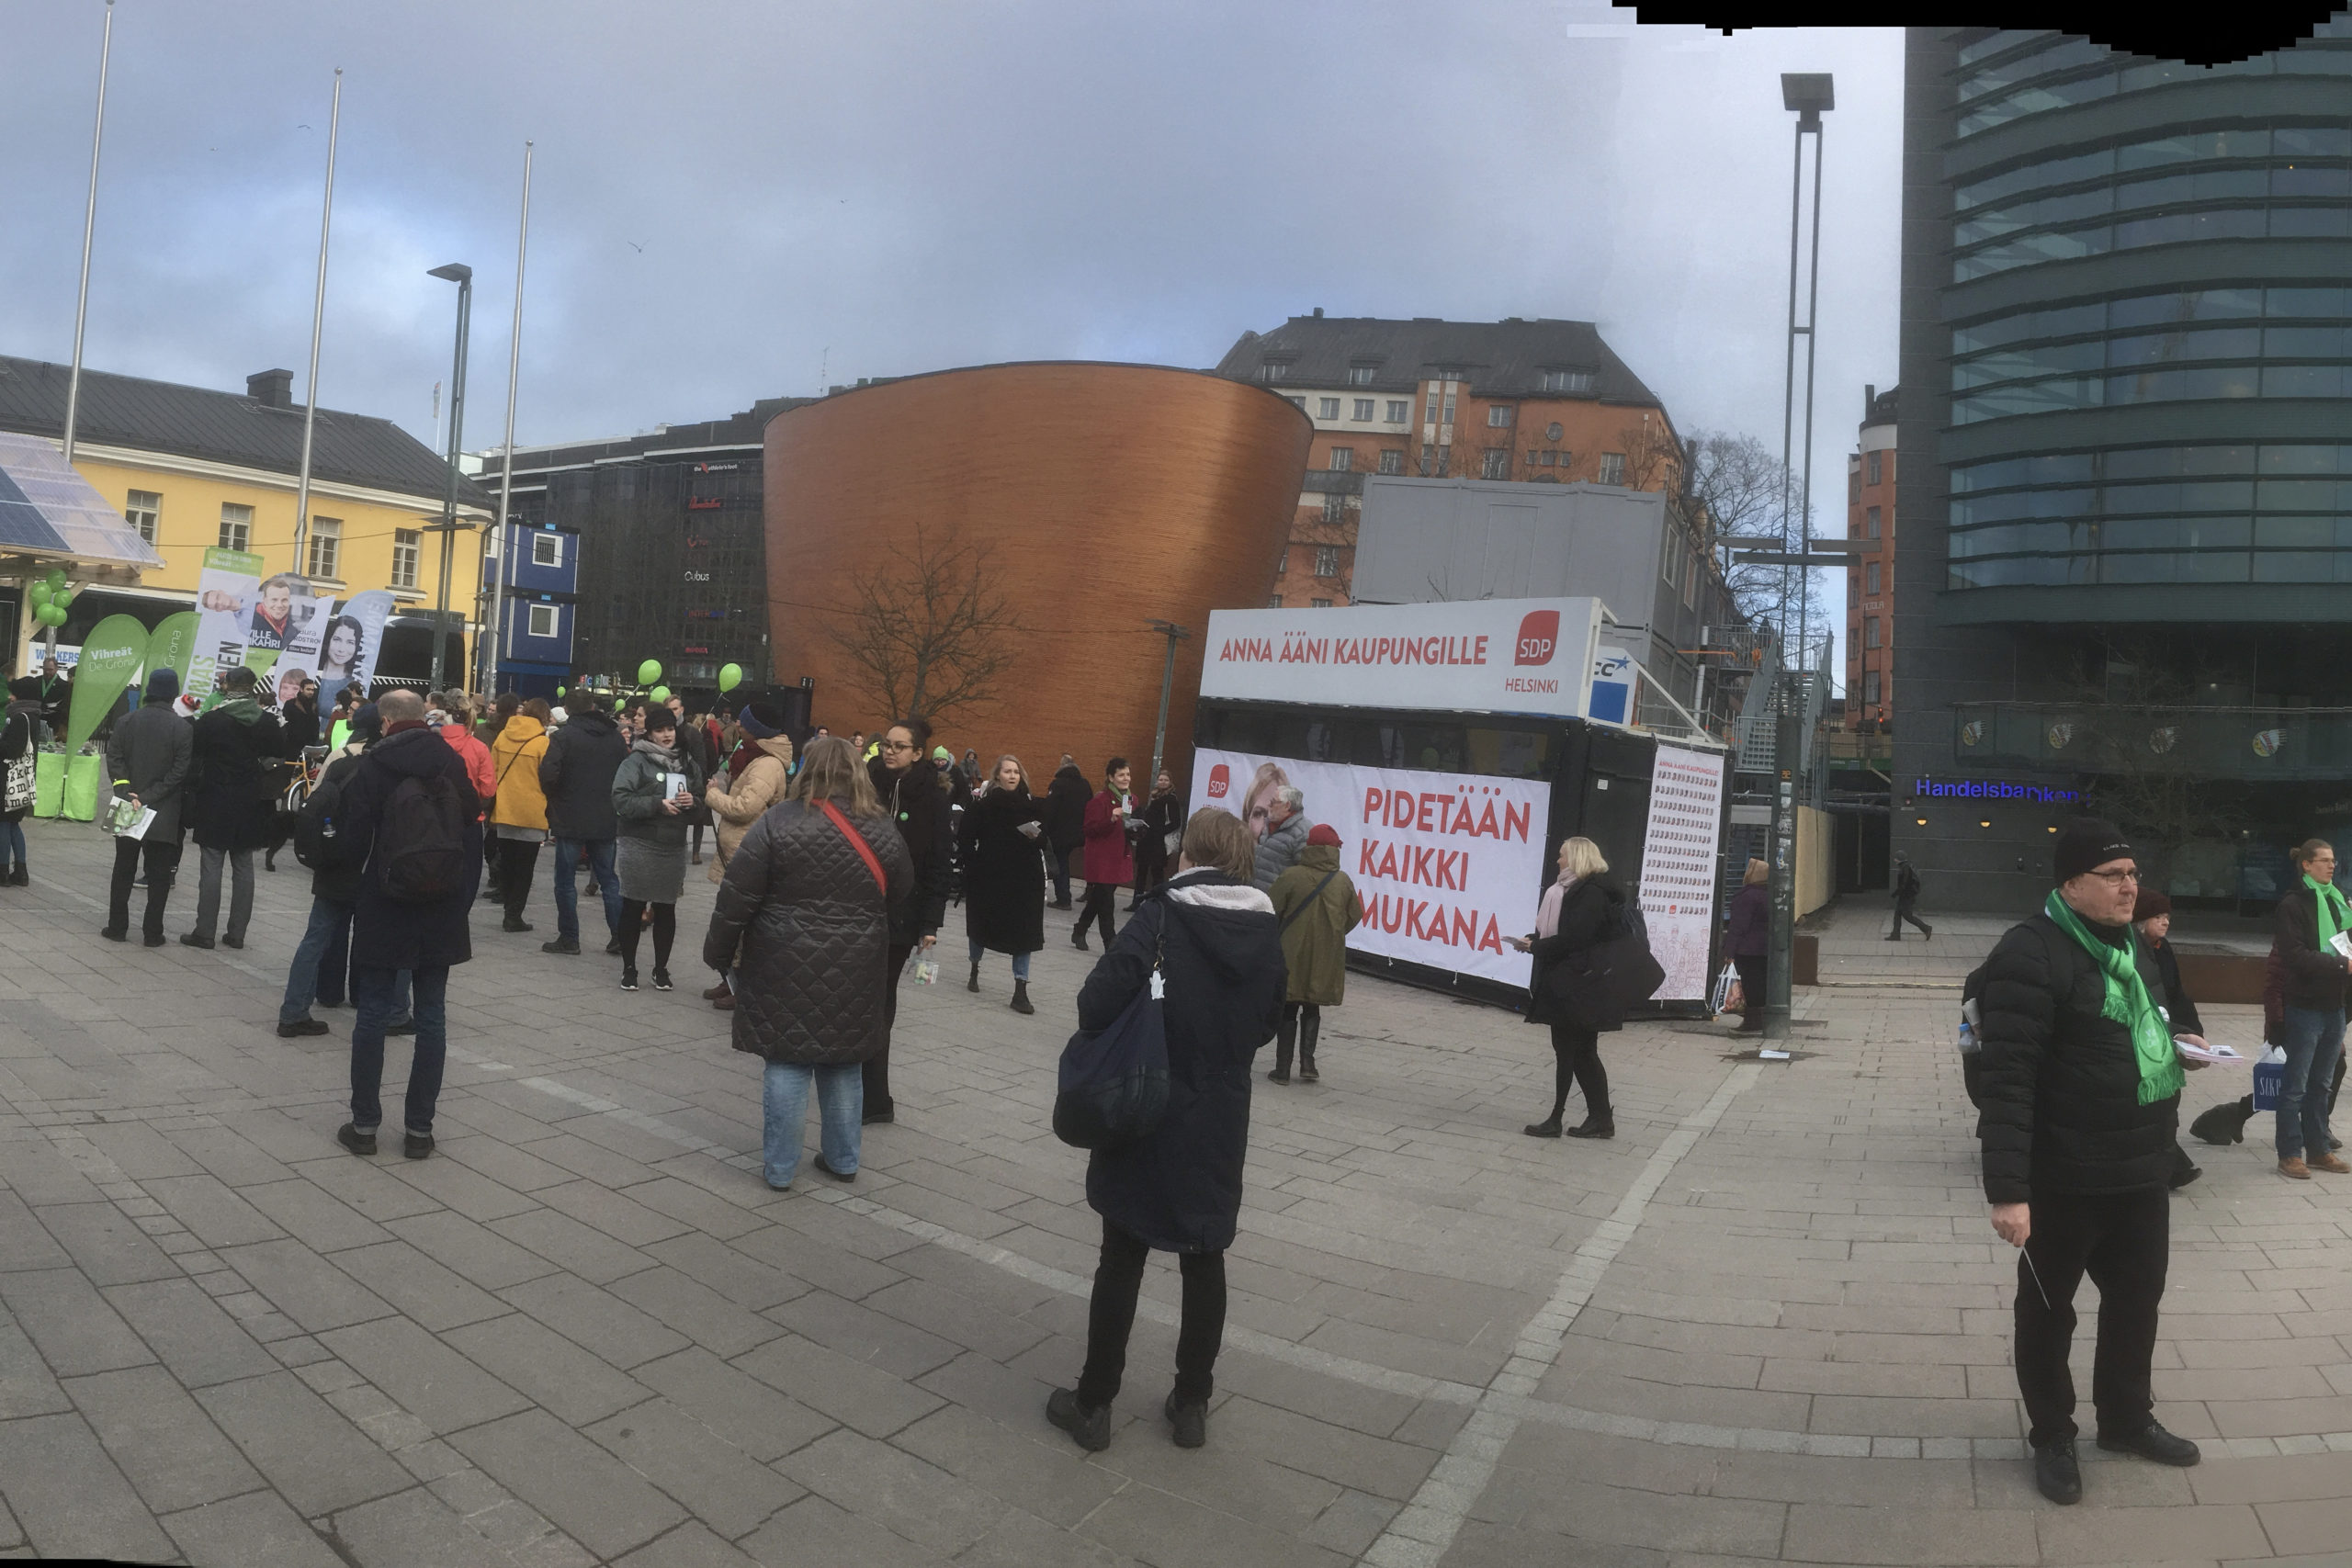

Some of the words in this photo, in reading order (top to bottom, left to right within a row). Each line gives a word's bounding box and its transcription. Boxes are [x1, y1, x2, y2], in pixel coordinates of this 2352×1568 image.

[684, 570, 710, 581] Cubus
[91, 647, 133, 660] Vihreät
[1219, 637, 1273, 662] ANNA
[1278, 630, 1329, 664] ÄÄNI
[1333, 635, 1488, 666] KAUPUNGILLE
[1519, 638, 1551, 658] SDP
[89, 660, 103, 672] De
[1505, 678, 1559, 694] HELSINKI
[1210, 780, 1227, 794] SDP
[1363, 784, 1531, 844] PIDETÄÄN
[1359, 838, 1469, 892] KAIKKI
[1356, 888, 1504, 956] MUKANA
